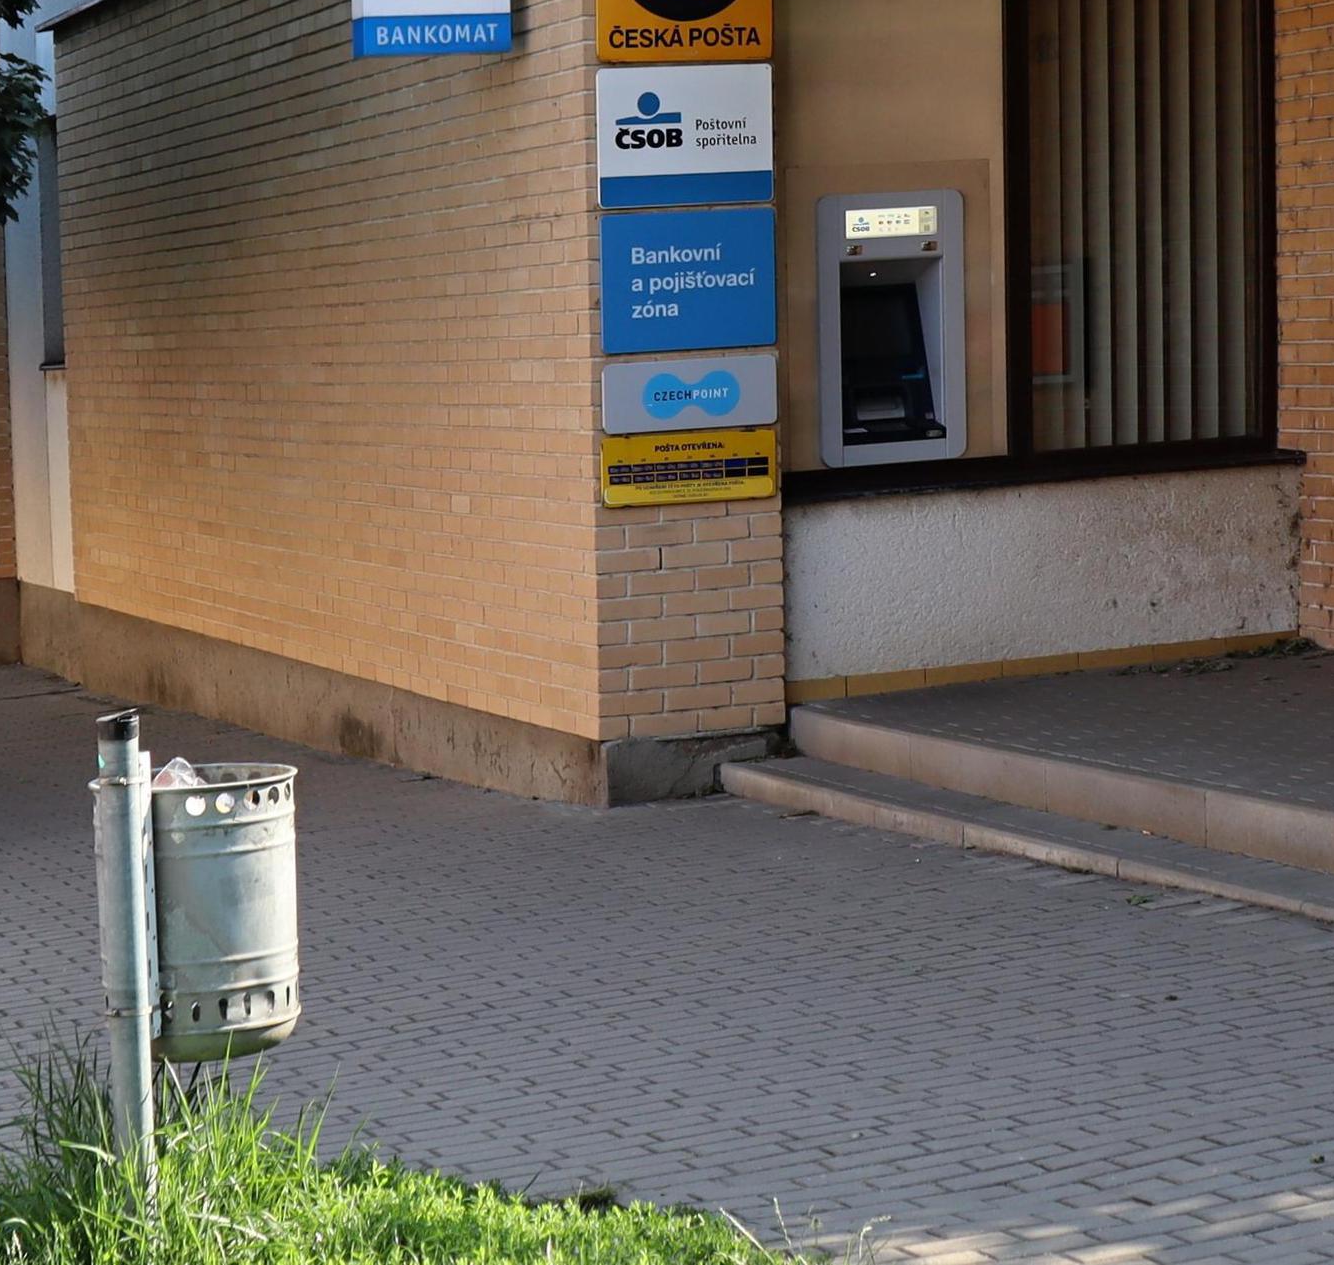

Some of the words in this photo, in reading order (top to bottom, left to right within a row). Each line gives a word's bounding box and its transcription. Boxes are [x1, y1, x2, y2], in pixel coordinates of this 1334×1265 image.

[375, 23, 499, 46] BANKOMAT
[609, 25, 684, 49] ČESKÁ
[689, 23, 761, 47] POŠTA
[695, 117, 747, 131] Poštovní
[615, 127, 683, 150] ČSOB
[695, 133, 757, 149] spořitelna
[631, 243, 723, 265] Bankovní
[631, 278, 643, 292] a
[649, 267, 757, 295] pojišťovací
[631, 300, 679, 319] zóna
[654, 443, 680, 453] POŠTA
